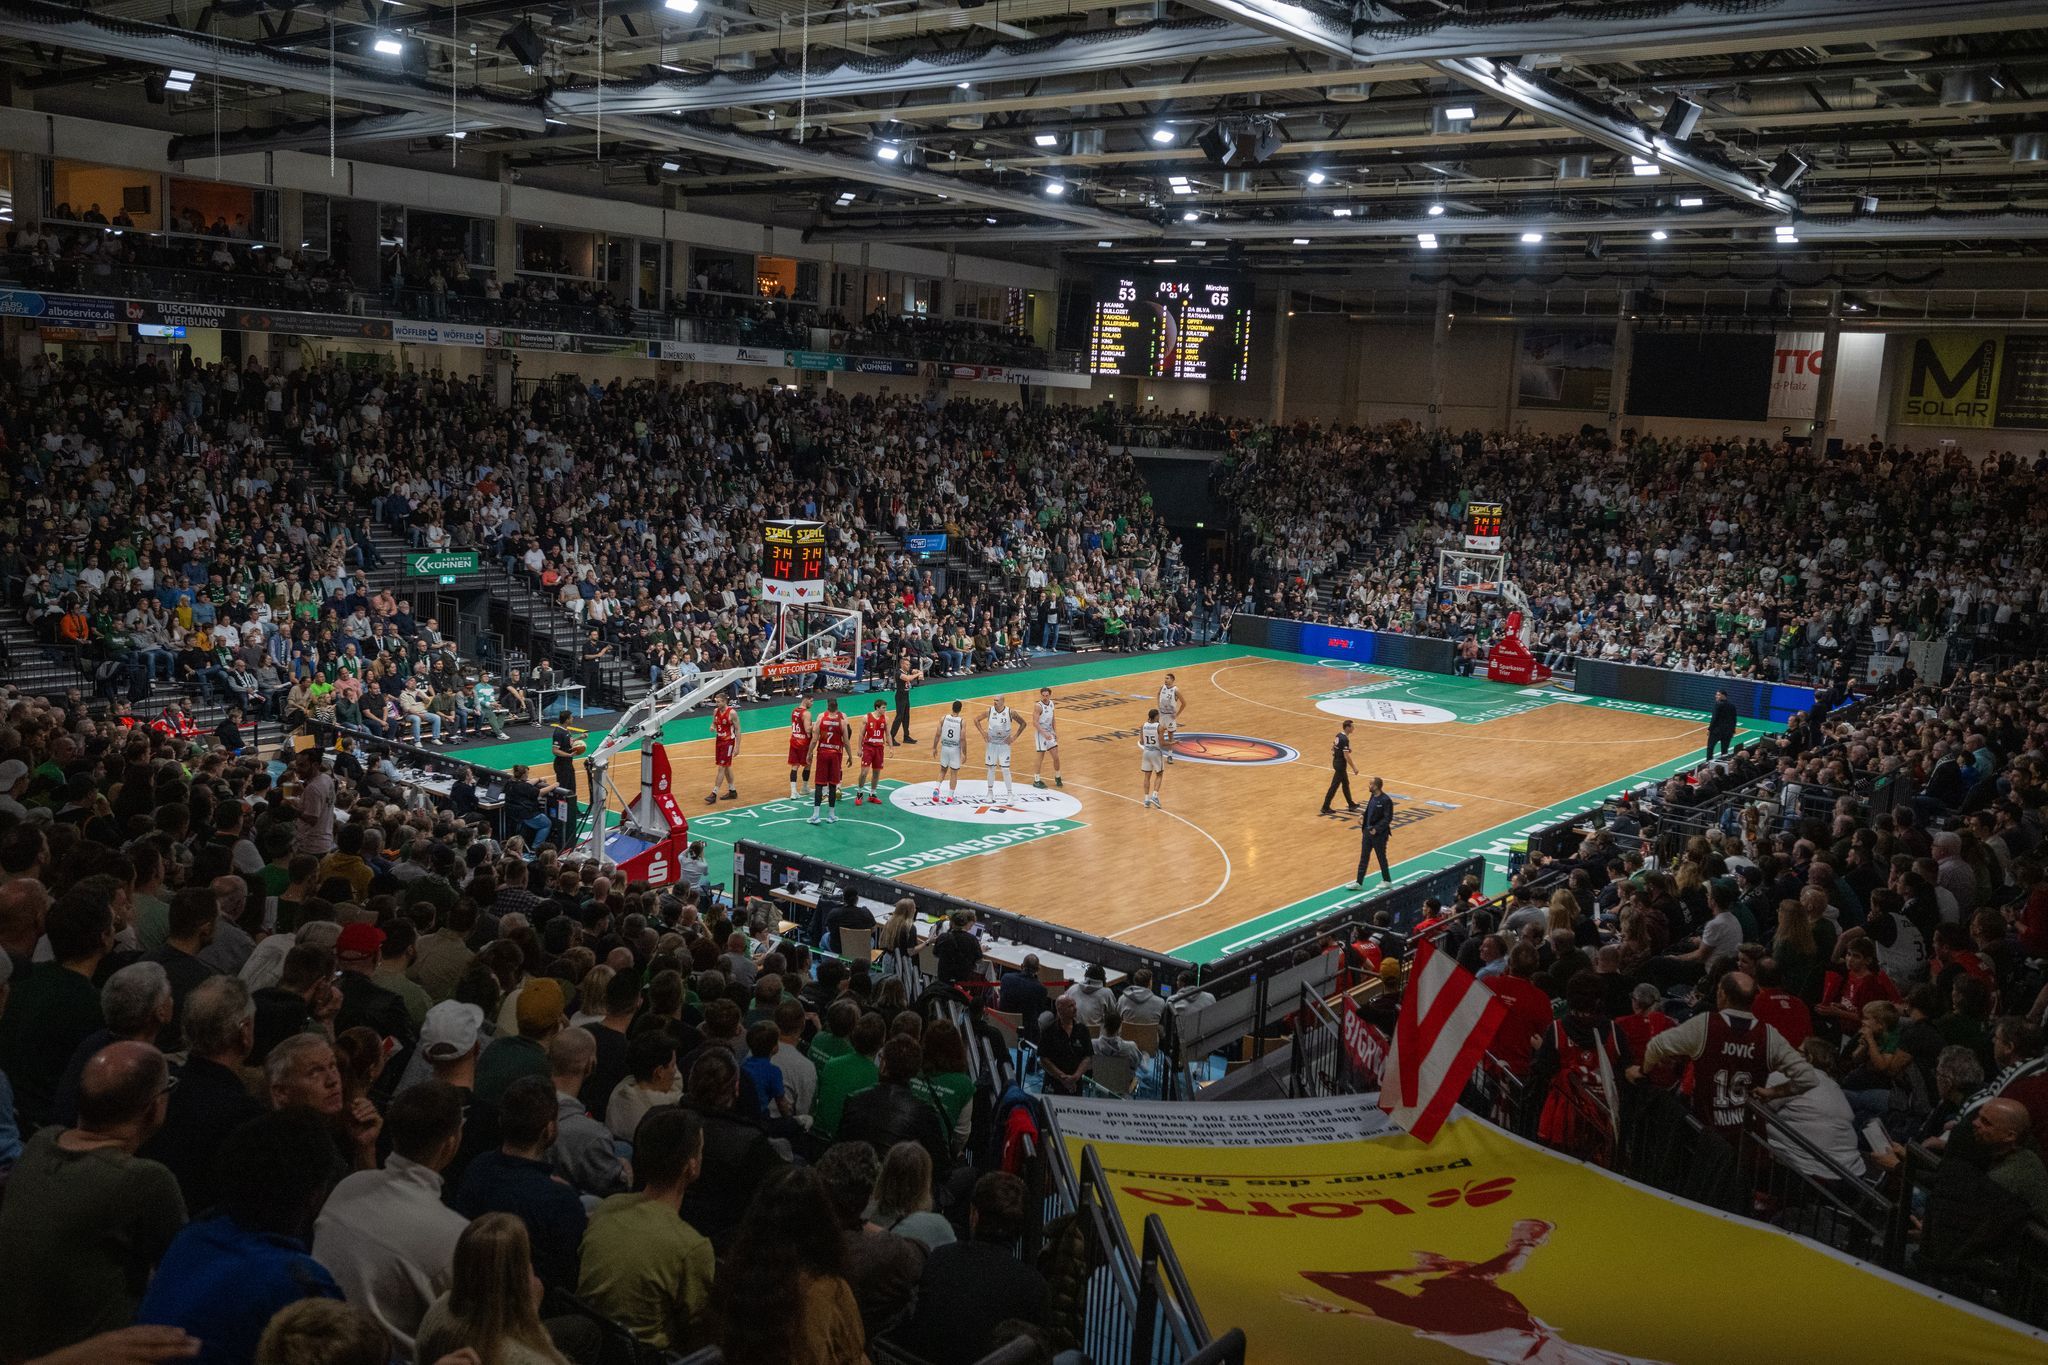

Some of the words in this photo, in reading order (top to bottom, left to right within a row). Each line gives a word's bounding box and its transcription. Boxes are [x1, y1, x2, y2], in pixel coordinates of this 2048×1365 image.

[1160, 282, 1190, 293] 03:14
[1119, 288, 1136, 300] 53
[1211, 292, 1229, 306] 65
[48, 308, 115, 320] alboservice.de
[158, 304, 226, 318] BUSCHMANN
[164, 315, 219, 328] WERBUNG
[394, 327, 427, 337] WÖFFLER
[443, 330, 475, 340] WÖFFLER
[663, 351, 696, 361] DIMENSIONS
[1776, 350, 1824, 374] TTO
[1910, 338, 1996, 399] M
[1979, 344, 1994, 398] QUADRAT
[1906, 400, 1988, 418] SOLAR
[427, 560, 472, 569] KÜHNEN
[774, 560, 789, 578] 14
[804, 561, 819, 578] 14
[778, 662, 818, 675] VET-CONCEPT
[1499, 663, 1526, 672] Sparkasse
[792, 722, 800, 732] 16
[827, 732, 833, 743] 7
[948, 729, 954, 739] 8
[1145, 735, 1156, 744] 15
[863, 822, 1060, 875] SCHOENERGIE
[1722, 1042, 1755, 1060] JOVIĆ
[1713, 1069, 1752, 1108] 16
[1229, 1119, 1315, 1129] Informationen
[1189, 1130, 1233, 1138] süchtig
[1269, 1126, 1336, 1136] Glücksspiel
[1326, 1159, 1472, 1184] partner
[1122, 1188, 1416, 1220] LOTTO
